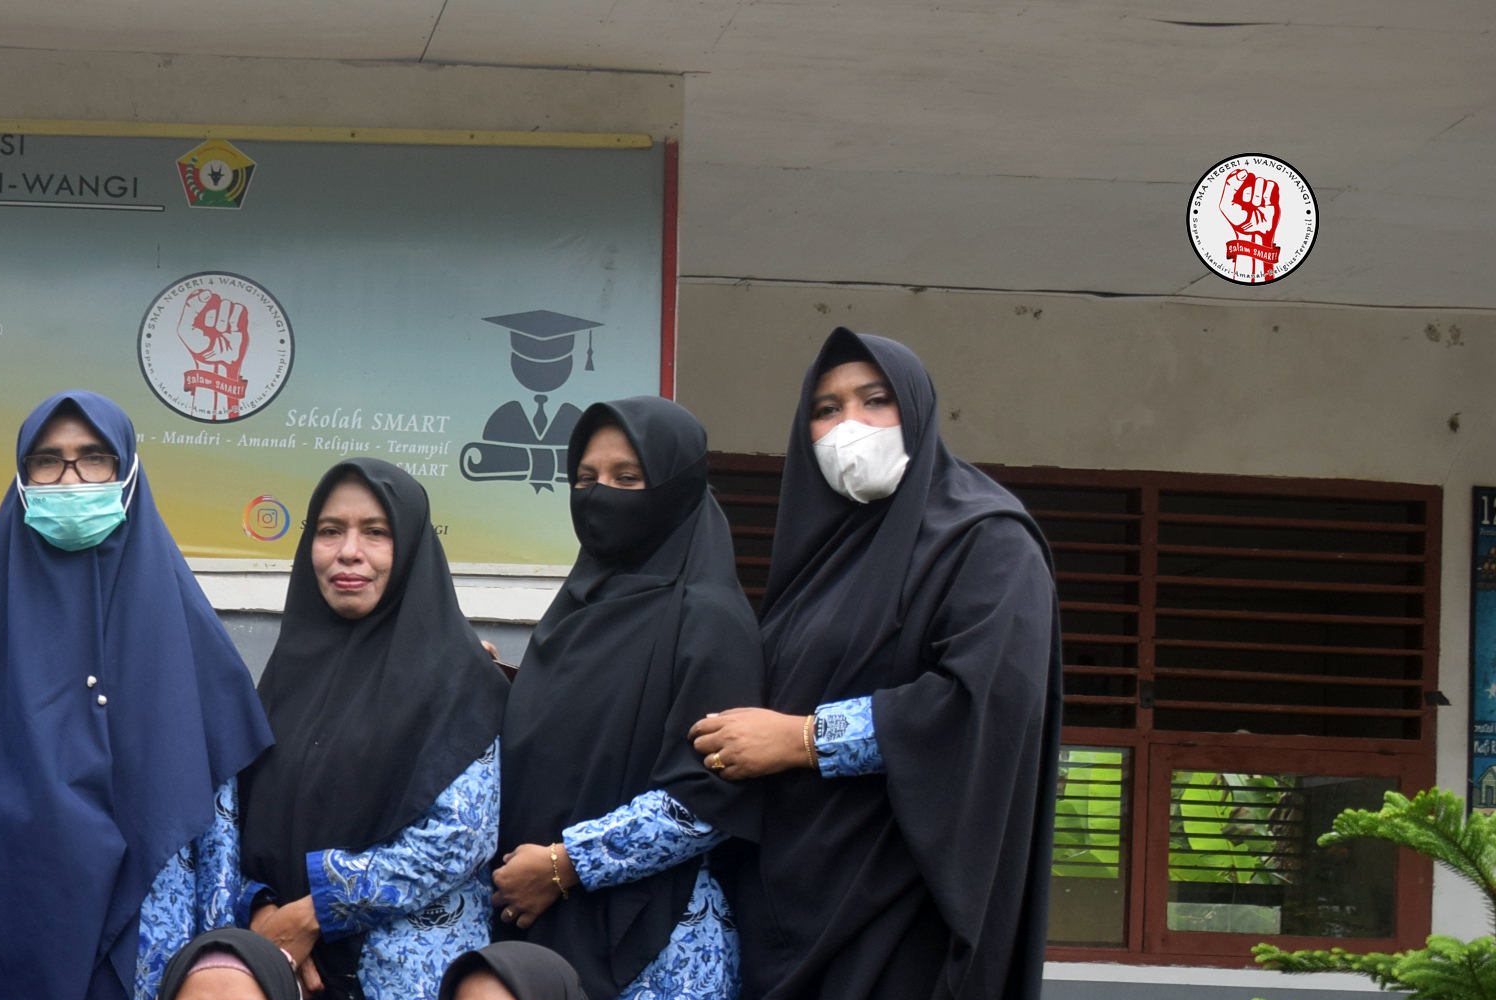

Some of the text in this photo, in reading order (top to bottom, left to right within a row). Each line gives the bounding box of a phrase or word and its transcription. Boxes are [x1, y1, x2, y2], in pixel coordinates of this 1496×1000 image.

[148, 305, 165, 330] SMA
[164, 278, 204, 304] NEGERI
[219, 277, 286, 333] WANGI-WANGI
[285, 407, 450, 434] Sekolah SMART
[162, 430, 220, 446] Mandiri
[237, 433, 296, 449] Amanah
[314, 436, 370, 456] Religius
[387, 440, 451, 459] Terampil
